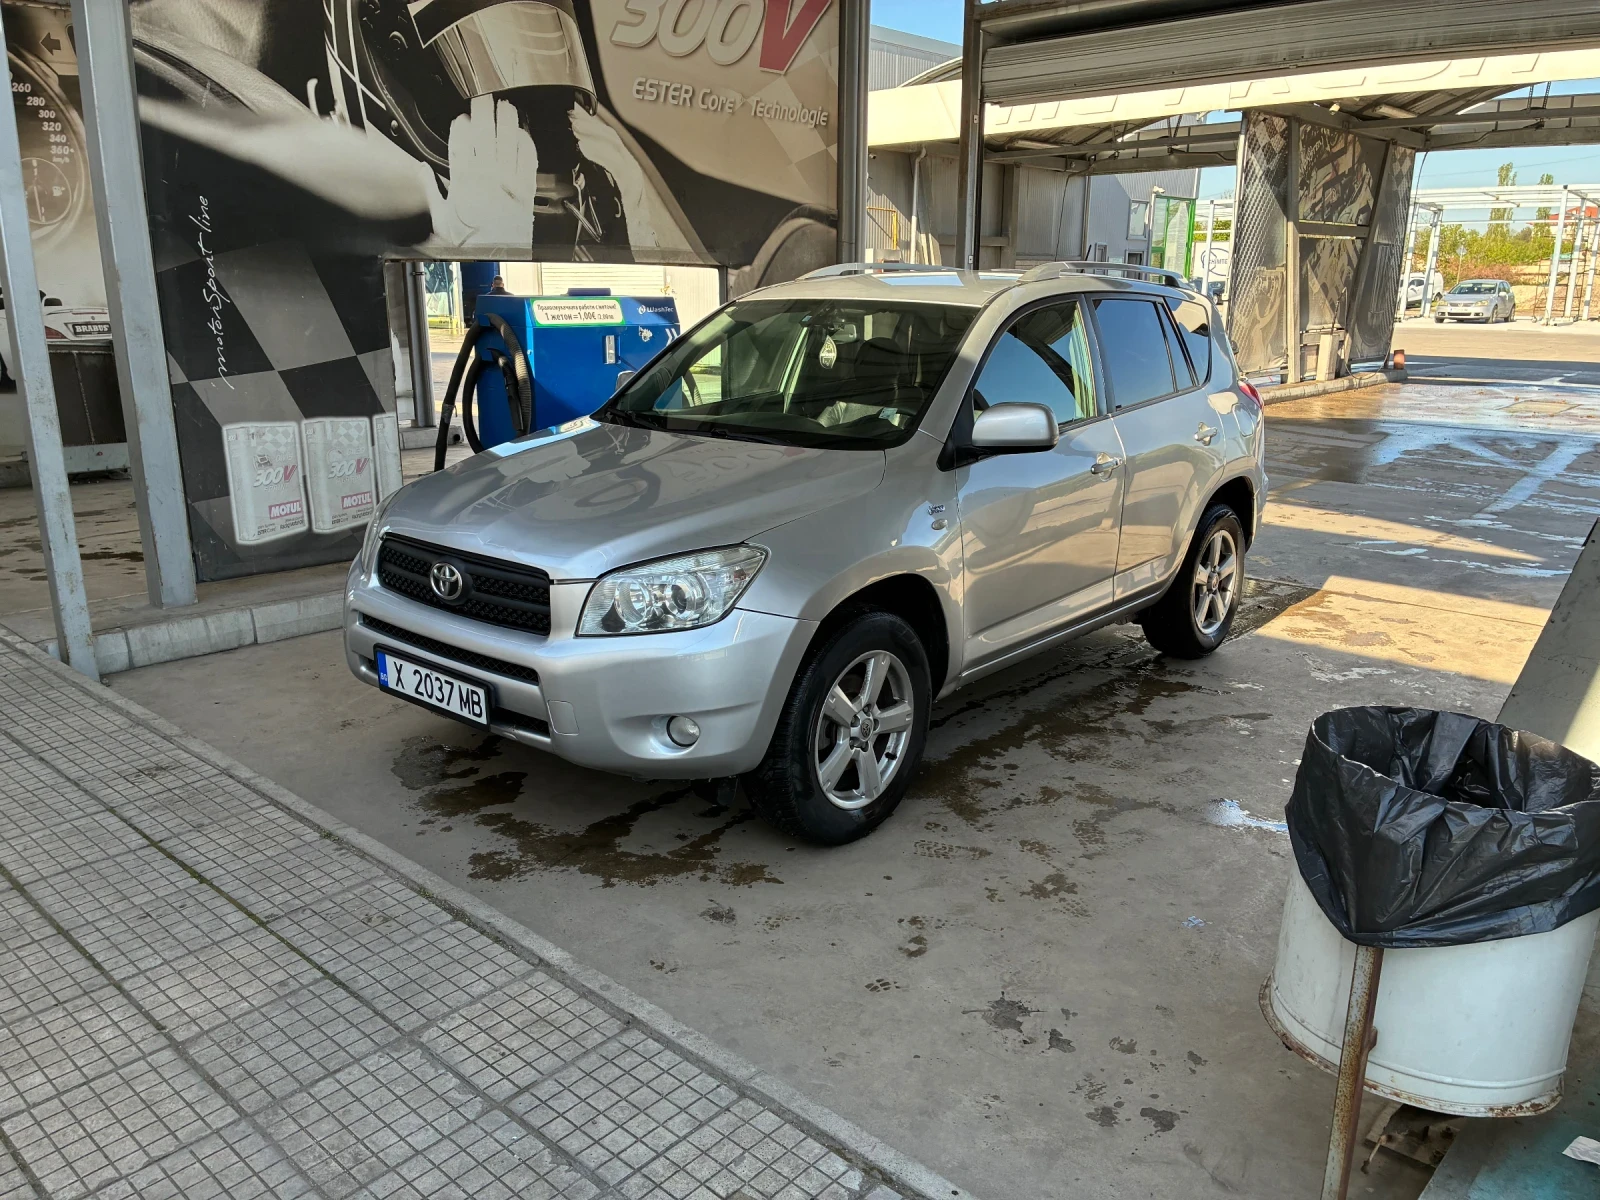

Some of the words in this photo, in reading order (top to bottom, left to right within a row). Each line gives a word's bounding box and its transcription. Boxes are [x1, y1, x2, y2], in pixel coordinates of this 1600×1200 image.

[12, 83, 31, 93] 260
[26, 96, 46, 106] 280
[632, 77, 693, 107] ESTER
[751, 97, 829, 129] Technologie
[38, 110, 56, 119] 300
[42, 122, 62, 131] 320
[49, 134, 67, 143] 340
[50, 146, 69, 155] 360
[188, 196, 212, 233] line
[74, 324, 110, 333] BRABUS
[328, 457, 371, 479] 300V
[253, 464, 298, 488] 300V
[343, 493, 372, 509] MOTUL
[270, 501, 302, 518] MOTUL
[393, 661, 405, 690] X
[413, 669, 455, 707] 2037
[458, 684, 483, 718] MB
